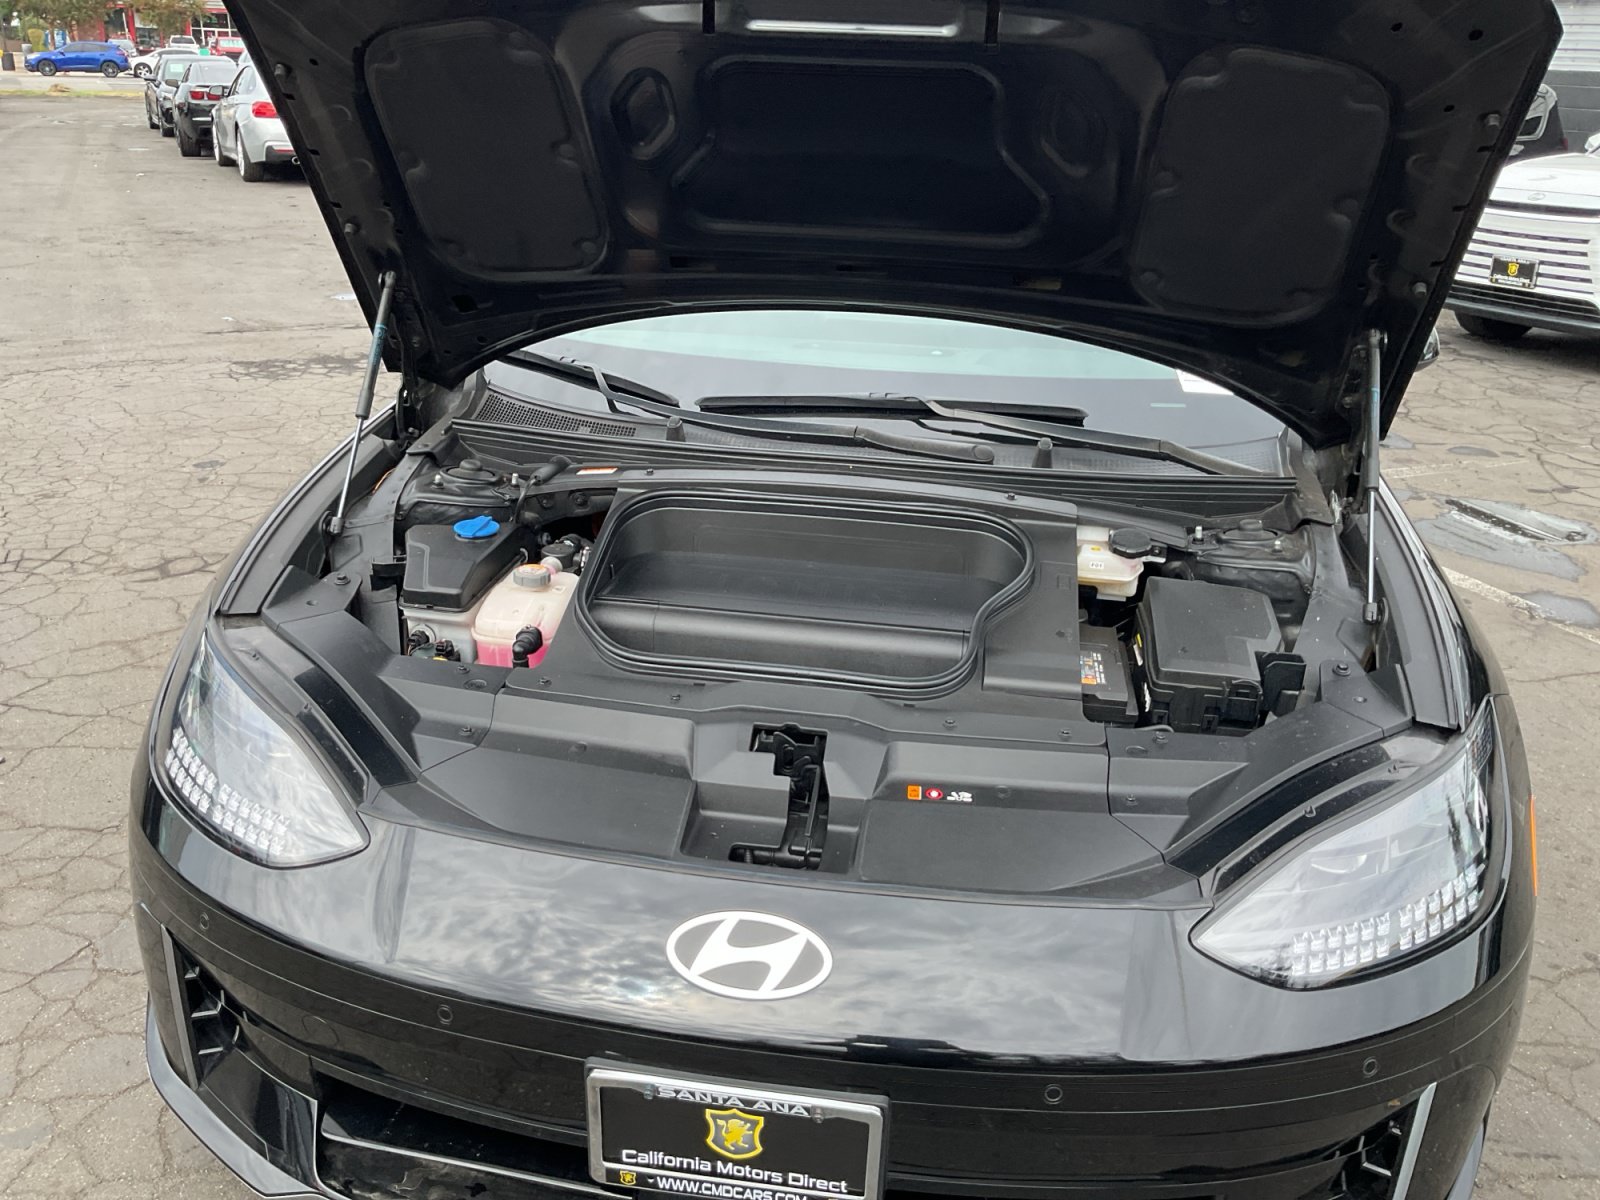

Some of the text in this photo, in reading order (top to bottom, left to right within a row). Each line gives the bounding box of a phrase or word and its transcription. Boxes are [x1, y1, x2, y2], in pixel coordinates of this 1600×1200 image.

[658, 1086, 809, 1117] SANTA ANA
[621, 1149, 848, 1193] California Motors Direct
[656, 1176, 807, 1200] WWW.CMDCARSCO
